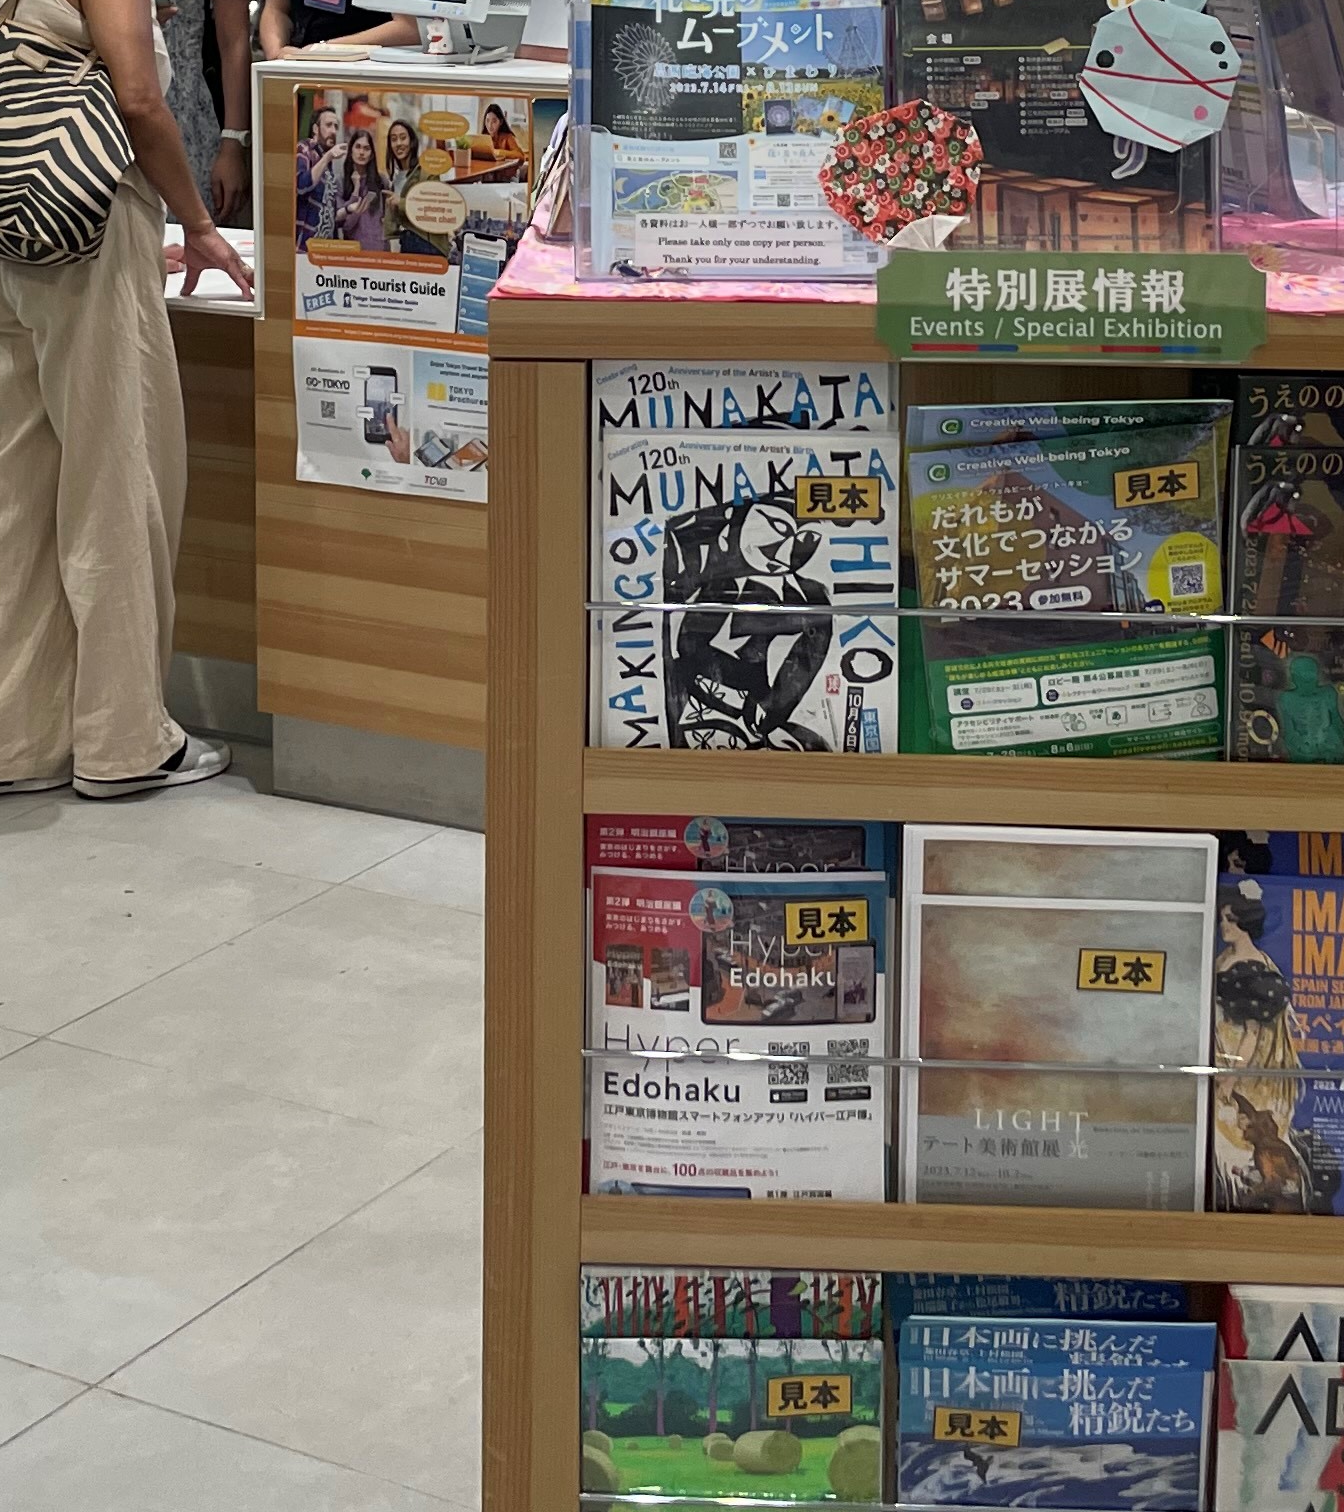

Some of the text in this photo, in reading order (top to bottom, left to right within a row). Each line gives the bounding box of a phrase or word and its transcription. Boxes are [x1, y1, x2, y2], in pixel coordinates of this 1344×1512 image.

[676, 13, 834, 63] ムーブメント
[658, 237, 689, 246] Please
[690, 237, 711, 246] take
[712, 237, 733, 248] only
[752, 240, 774, 248] copy
[775, 240, 791, 248] per
[793, 239, 825, 248] person.
[662, 255, 821, 266] Thank you for your understanding.
[315, 274, 446, 296] Online Tourist Guide
[946, 267, 1186, 314] 特別展情報
[306, 293, 332, 309] FREE
[910, 316, 984, 337] Events
[1013, 316, 1094, 341] Special
[1104, 317, 1223, 339] Exhibition
[628, 371, 679, 396] 120th
[668, 366, 721, 378] Anniversary
[722, 368, 731, 376] of
[732, 369, 746, 377] the
[748, 369, 780, 378] Artist's
[970, 414, 1144, 428] Creative Well-being Tokyo
[639, 446, 690, 471] 120th
[679, 441, 731, 453] Anniversary
[733, 443, 742, 451] of
[743, 444, 757, 452] the
[759, 444, 791, 454] Artist's
[956, 445, 1130, 472] Creative Well-being Tokyo
[806, 482, 868, 514] 見本
[1125, 469, 1187, 502] 見本
[931, 494, 1044, 530] だれもが
[932, 517, 1134, 562] 文化でつながる
[935, 550, 1143, 591] サマーセッション
[796, 906, 857, 939] 見本
[1088, 954, 1154, 987] 見本
[1293, 978, 1329, 994] SPAIN
[1293, 994, 1325, 1009] FROM
[604, 1071, 740, 1103] Edohaku
[973, 1107, 1089, 1136] LIGHT
[923, 1136, 1061, 1158] テート美術館展
[923, 1326, 1158, 1354] 日本画に挑んだ
[778, 1379, 840, 1410] 見本
[923, 1366, 1157, 1402] 日本画に挑んだ
[944, 1413, 1009, 1440] 見本
[1068, 1401, 1196, 1436] 精鋭たち
